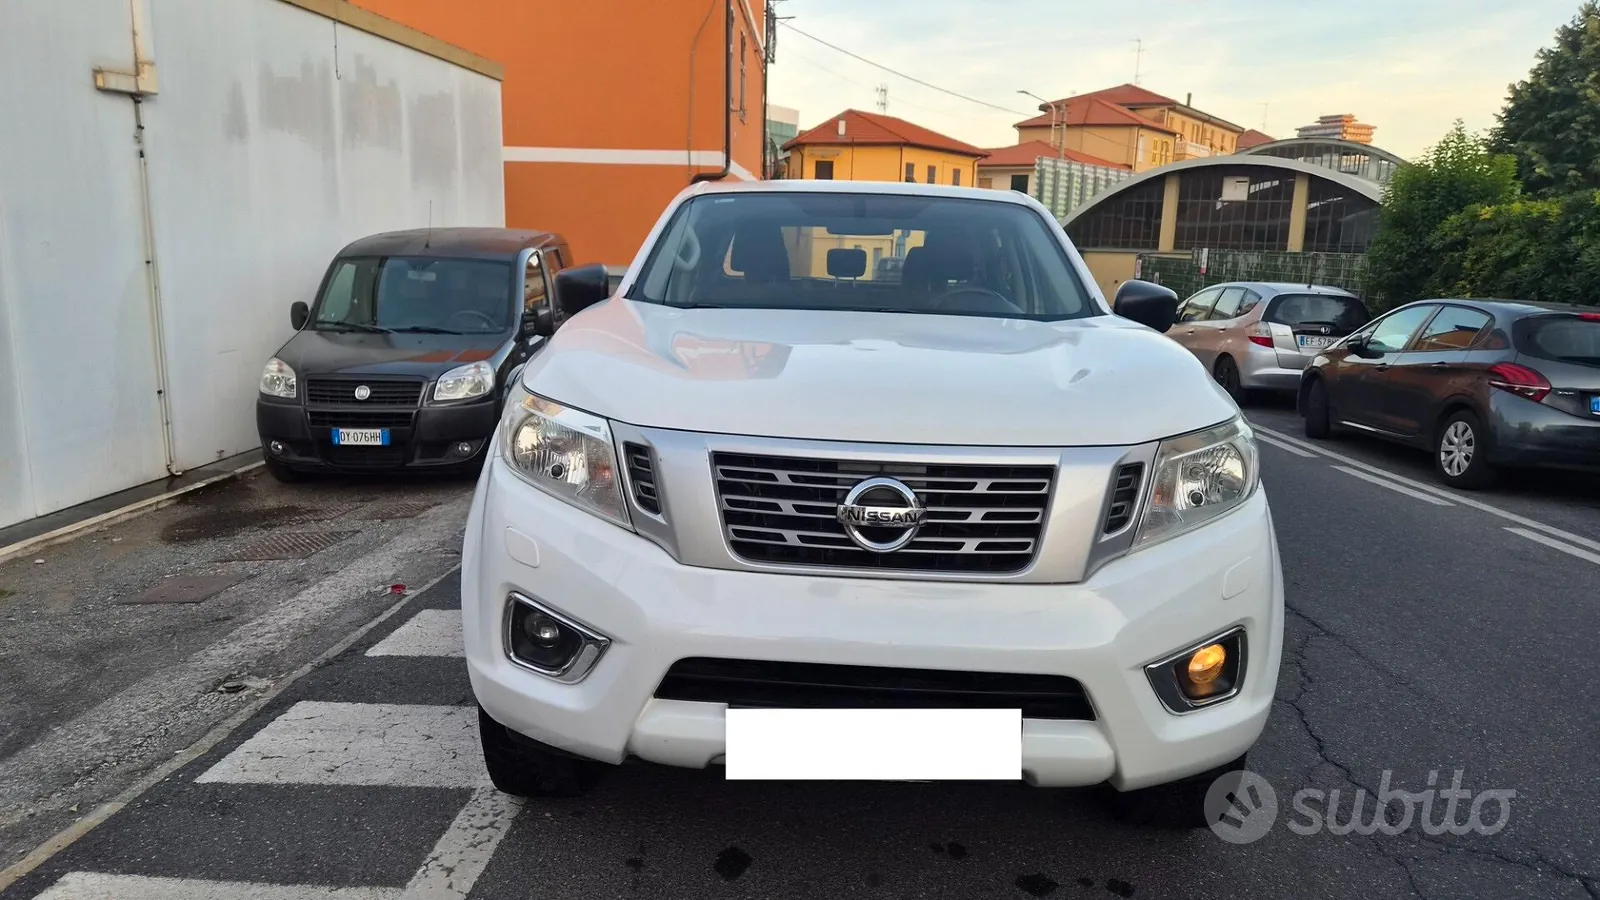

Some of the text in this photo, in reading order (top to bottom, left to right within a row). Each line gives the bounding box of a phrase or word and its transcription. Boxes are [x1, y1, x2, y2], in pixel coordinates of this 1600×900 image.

[340, 431, 381, 442] DY 076HH
[847, 508, 918, 523] NISSAN
